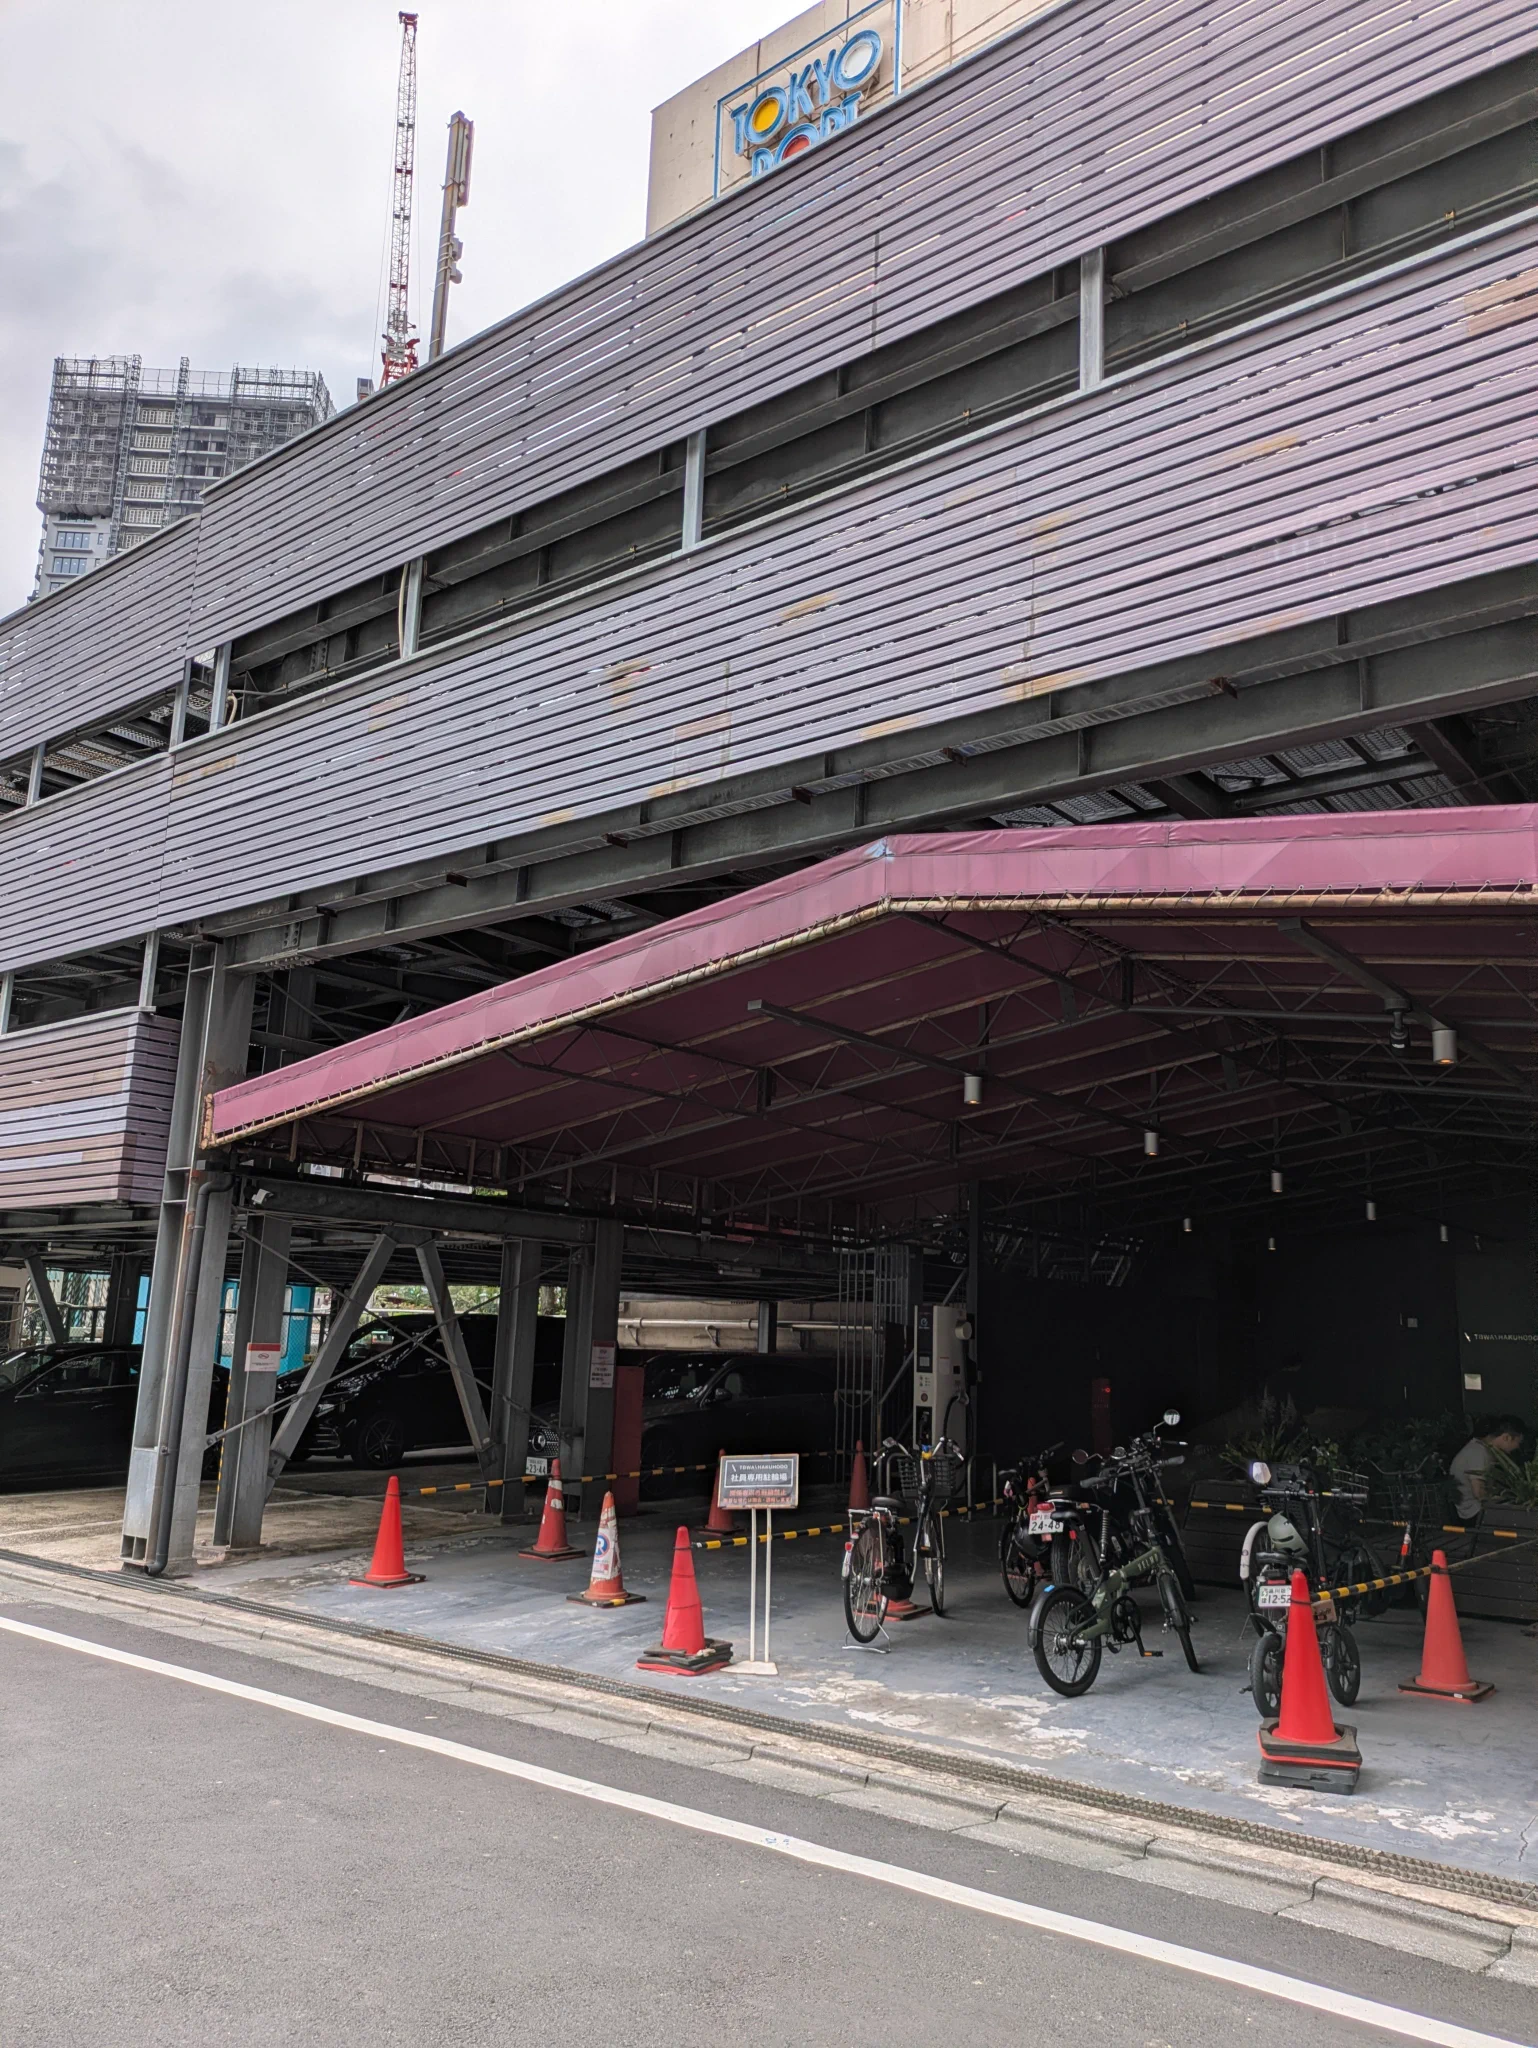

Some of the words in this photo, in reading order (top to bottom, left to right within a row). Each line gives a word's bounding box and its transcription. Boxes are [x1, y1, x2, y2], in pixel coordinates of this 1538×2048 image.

[730, 29, 883, 157] TOKYO
[731, 1472, 788, 1482] 社員専用駐輪場
